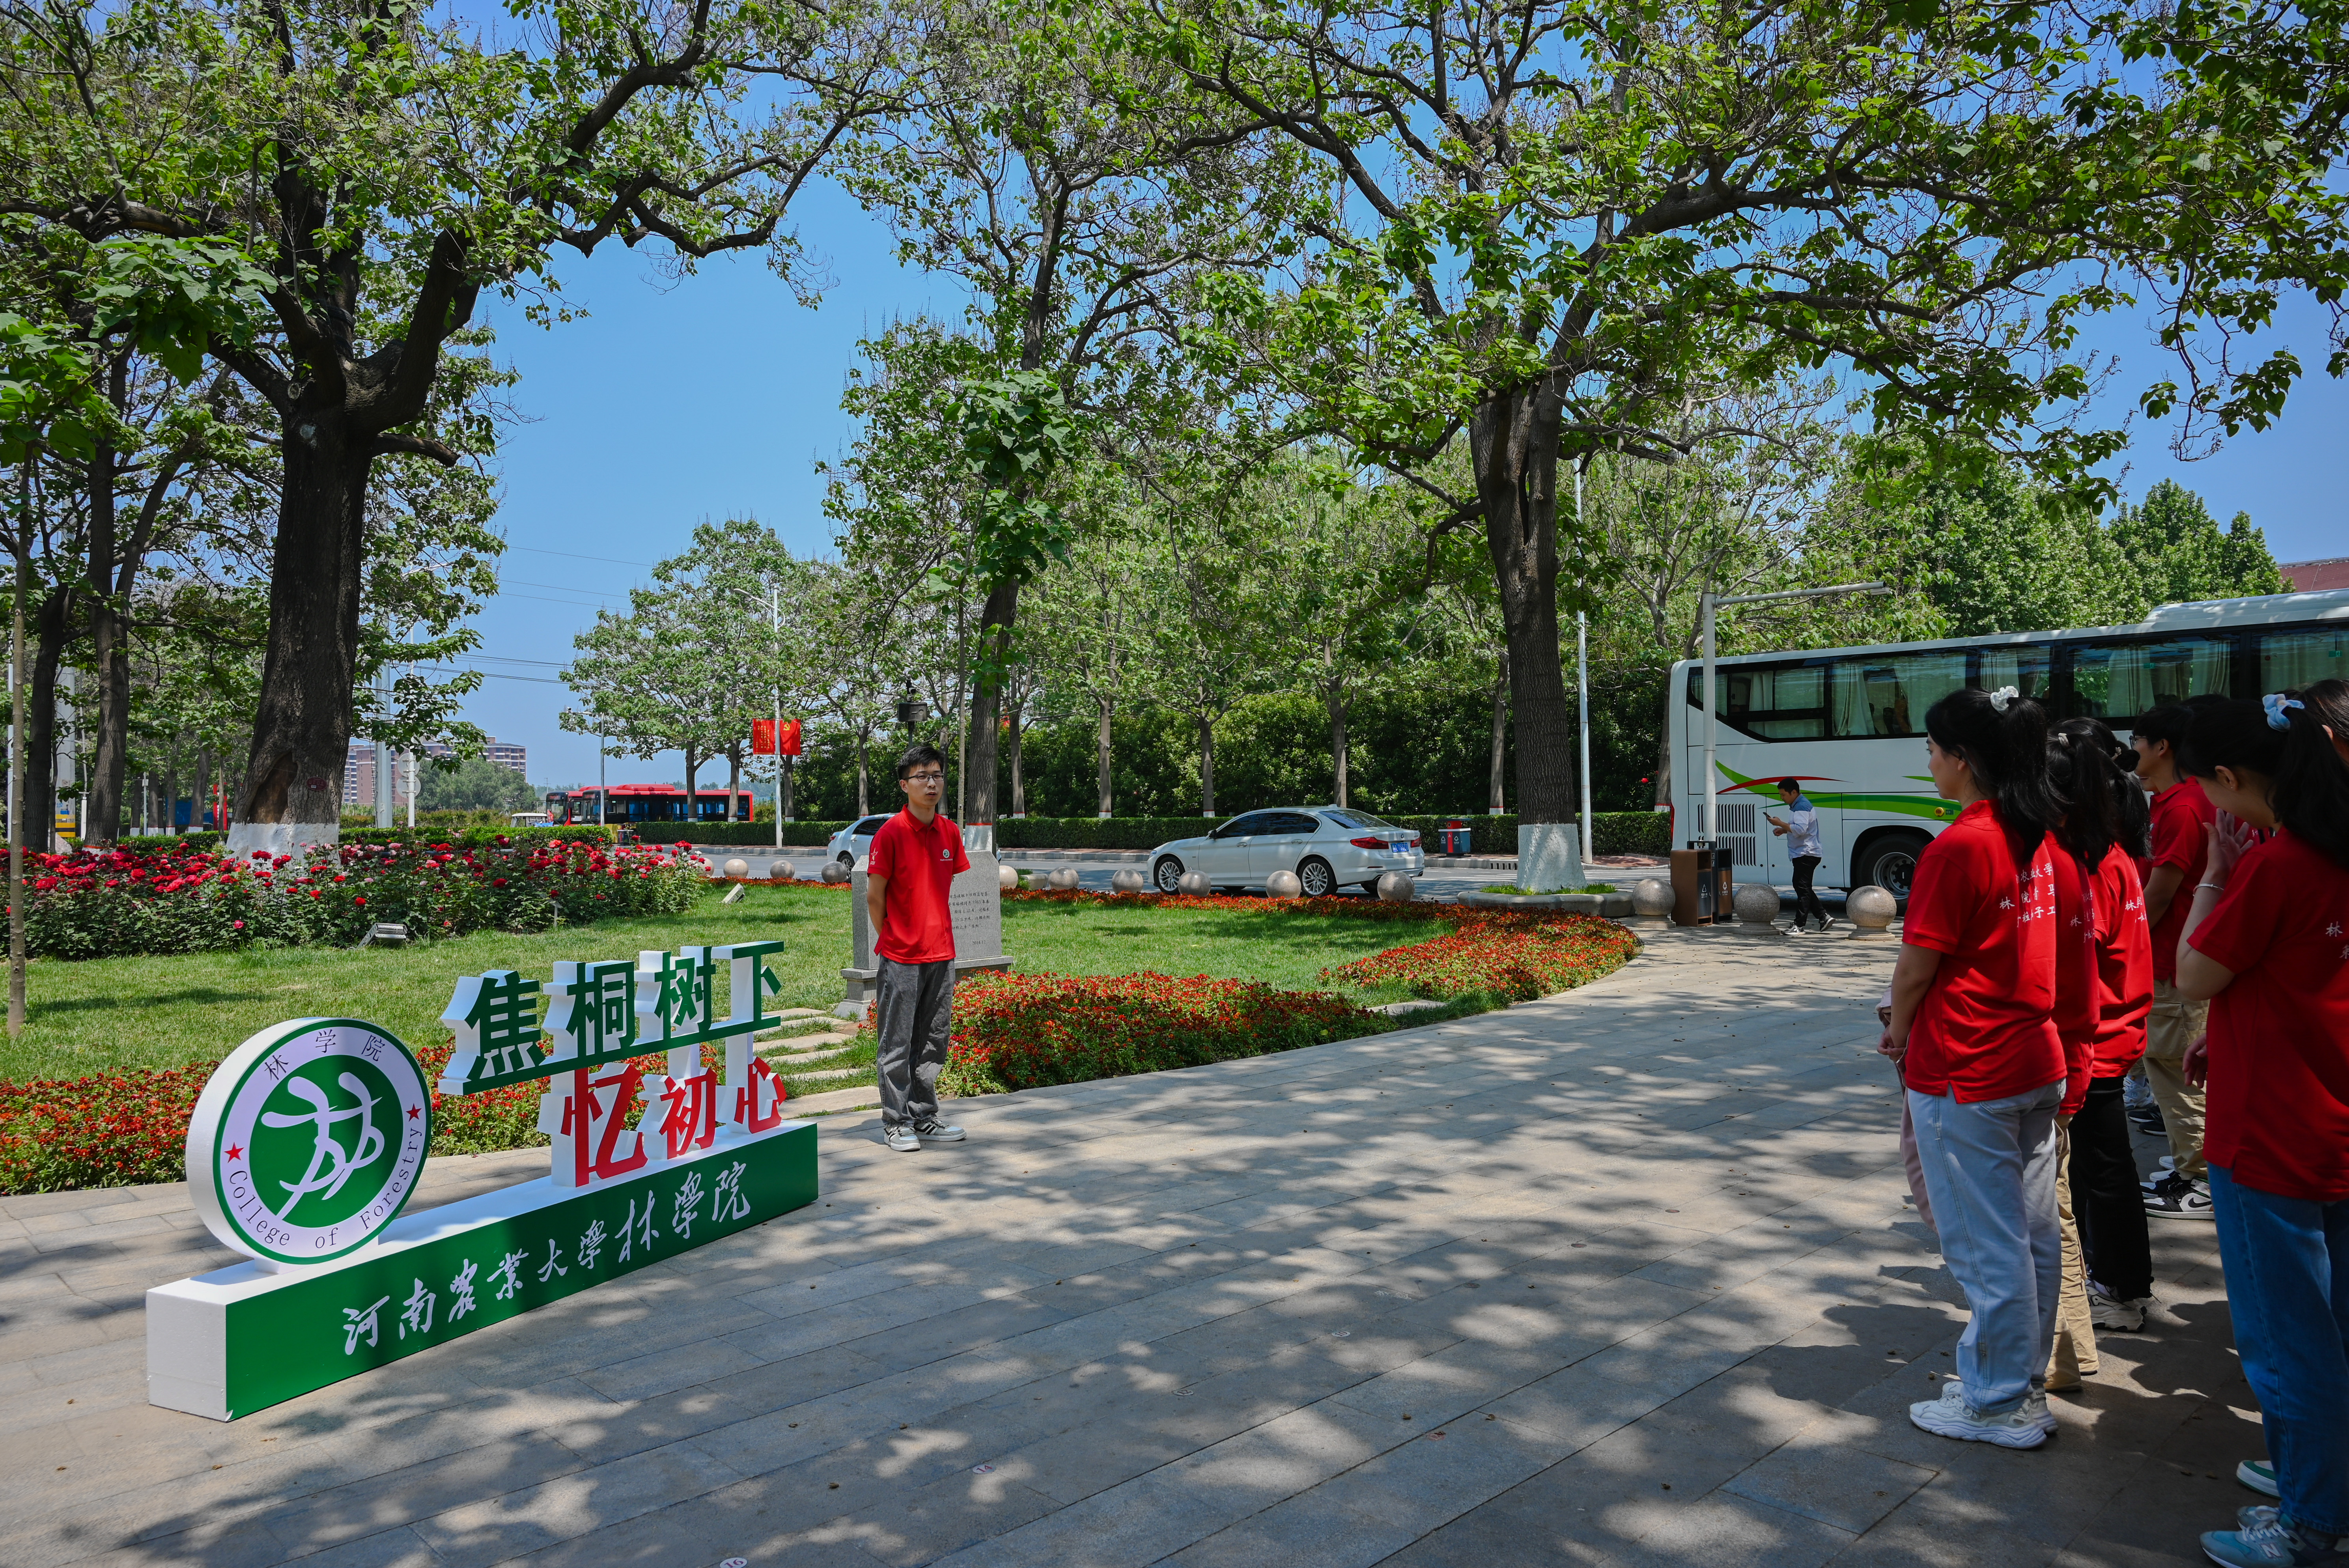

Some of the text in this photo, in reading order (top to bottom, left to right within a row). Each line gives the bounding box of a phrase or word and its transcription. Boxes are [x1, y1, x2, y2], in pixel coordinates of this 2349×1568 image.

[2325, 921, 2343, 937] 林
[263, 1029, 385, 1081] 林学院
[463, 941, 784, 1083] 焦桐树下
[560, 1057, 787, 1187] 忆初心
[230, 1127, 422, 1249] College of Forestry
[2260, 1543, 2282, 1558] N
